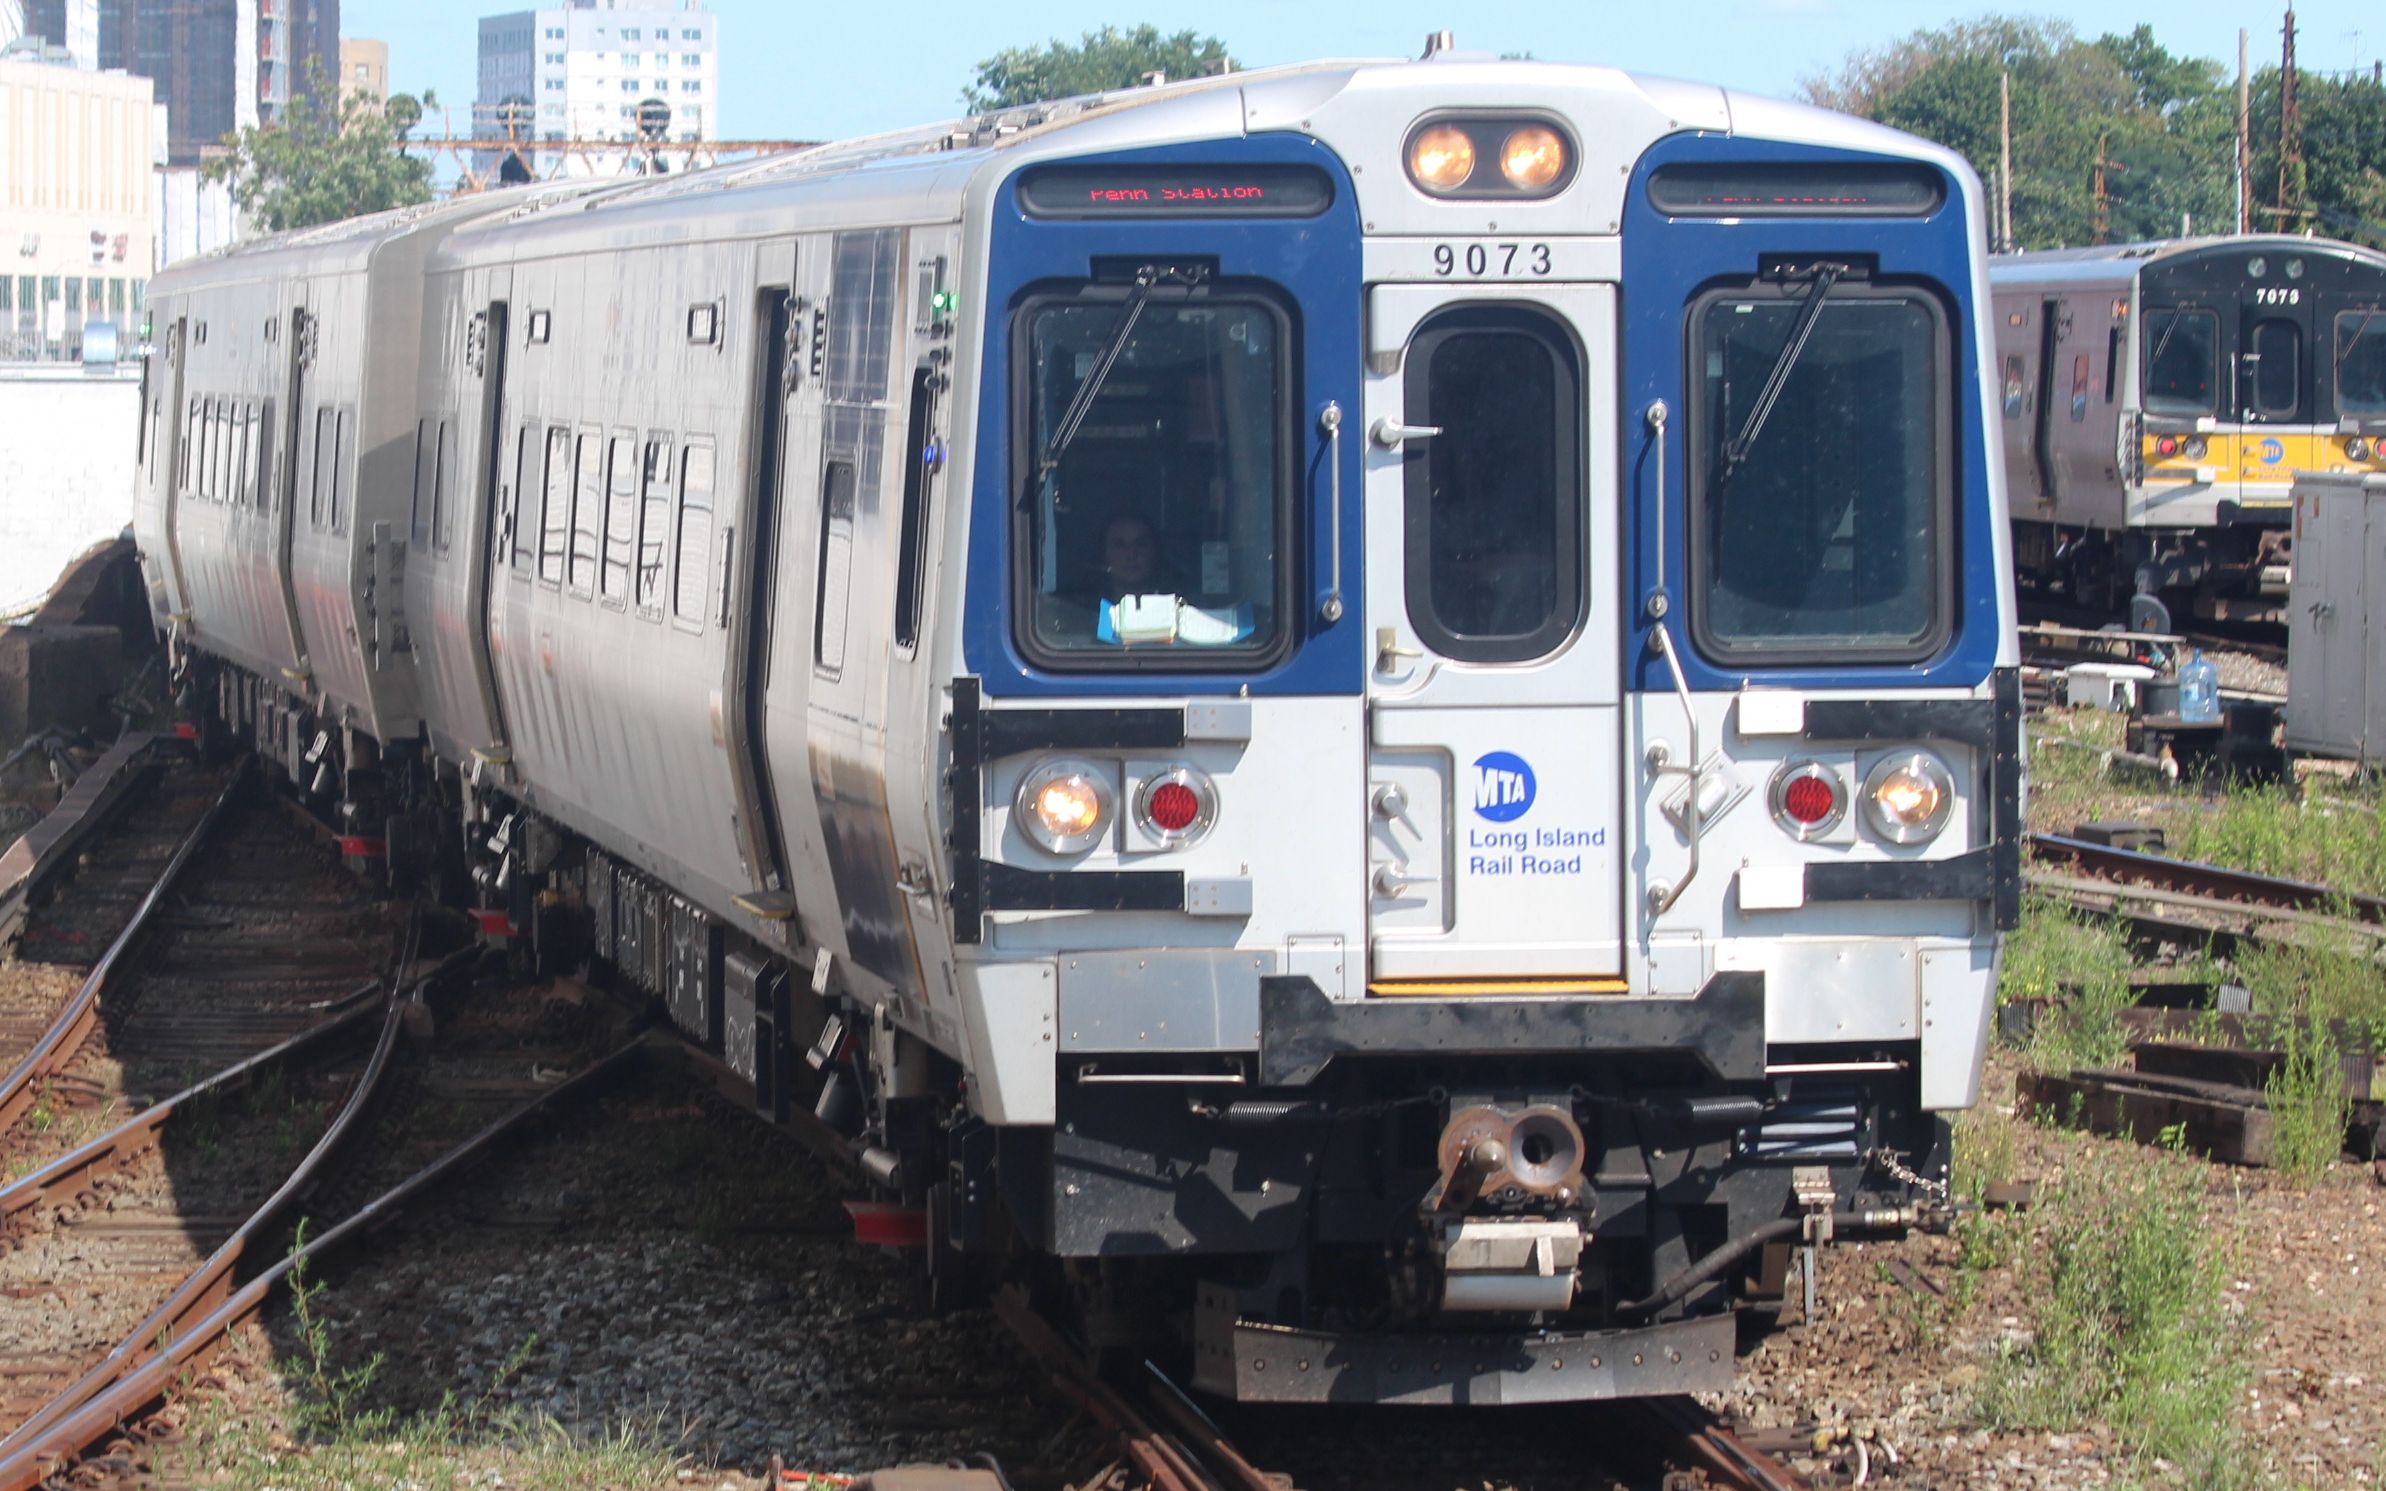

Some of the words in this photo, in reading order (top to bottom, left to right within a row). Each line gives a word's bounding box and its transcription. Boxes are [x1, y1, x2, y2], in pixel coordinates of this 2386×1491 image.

[1434, 244, 1552, 275] 9073
[1472, 765, 1526, 809] MTA
[1470, 829, 1528, 851] Long
[1537, 827, 1606, 846] Island
[1470, 857, 1512, 875] Rail
[1522, 855, 1581, 874] Road
